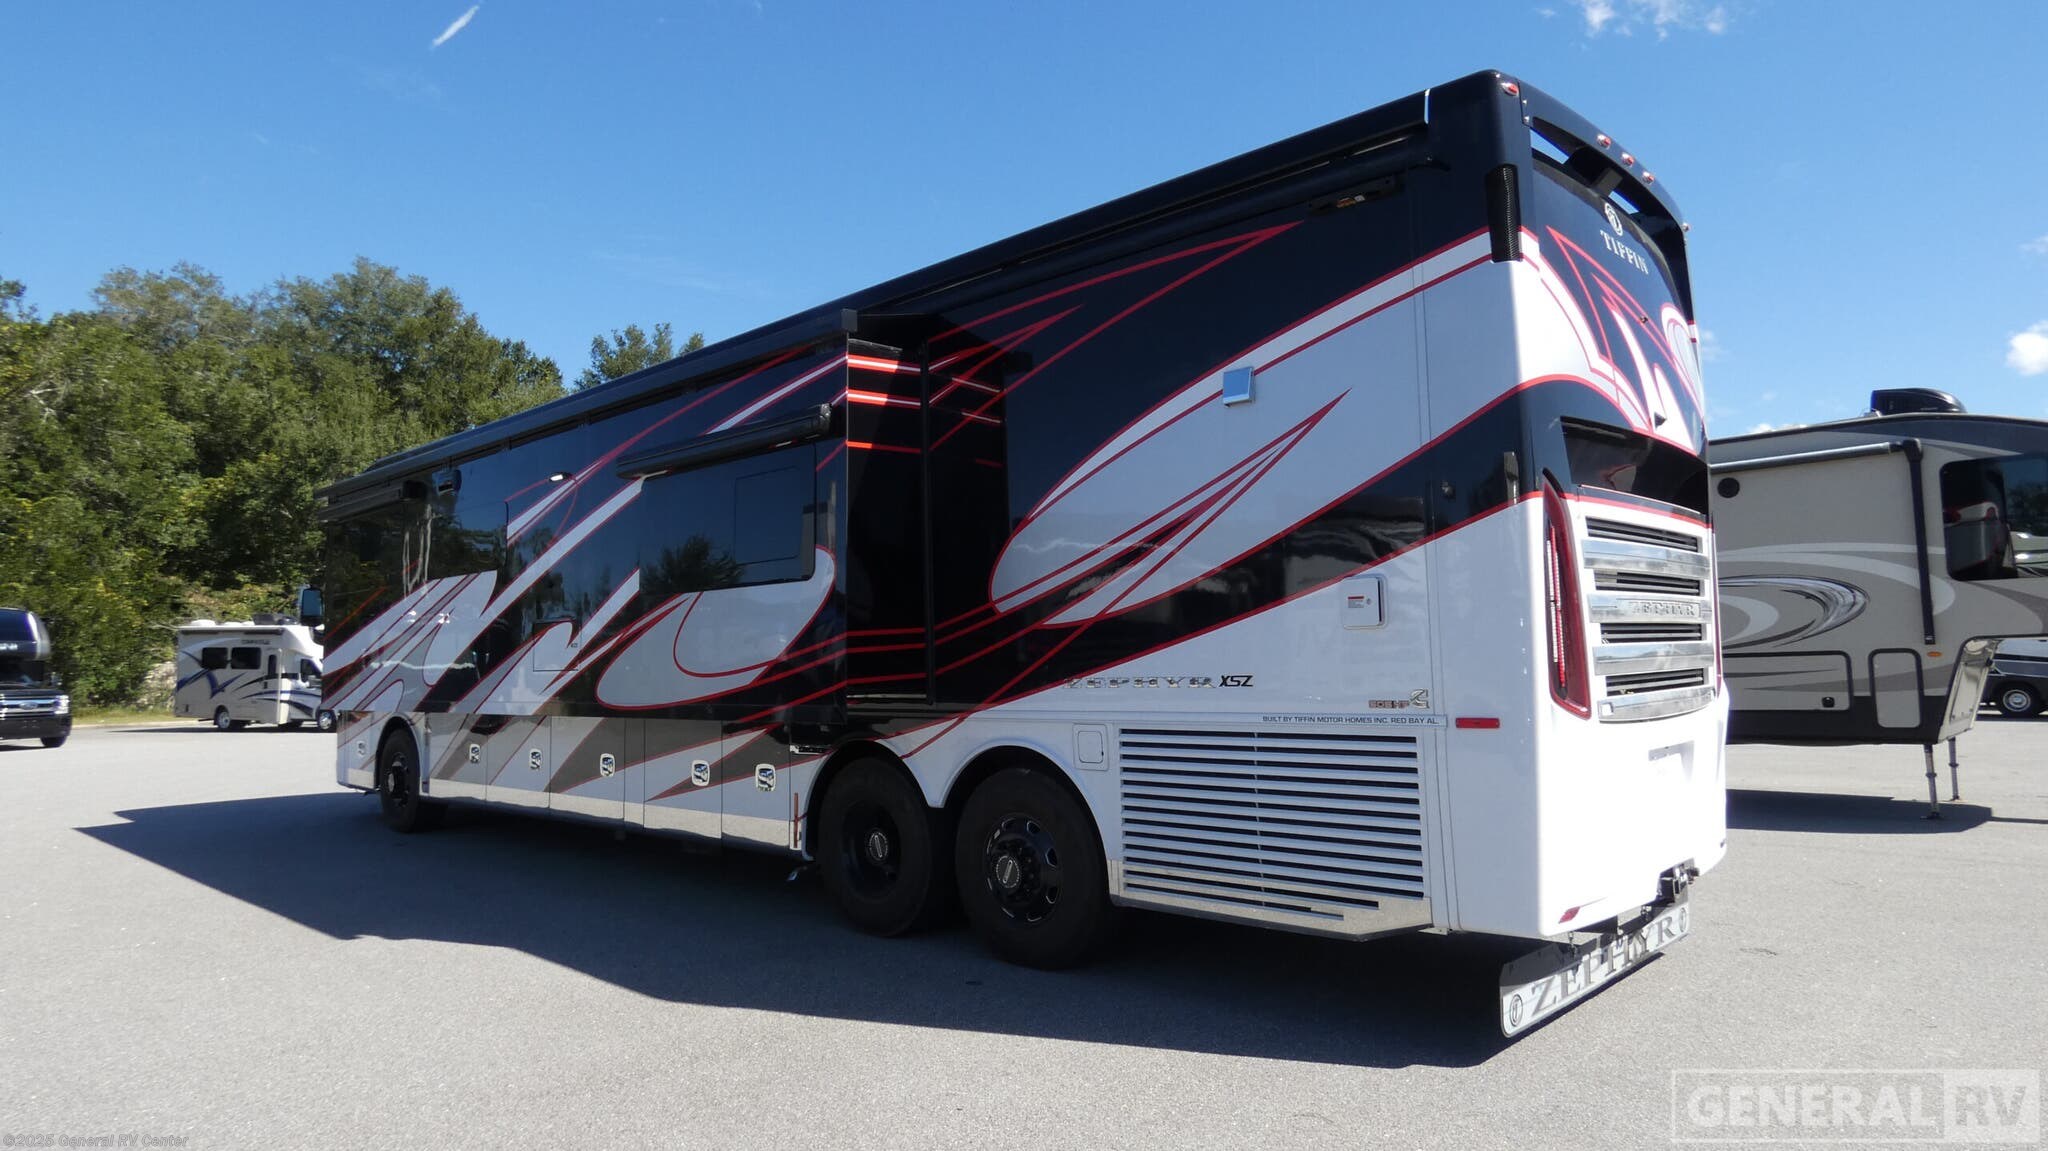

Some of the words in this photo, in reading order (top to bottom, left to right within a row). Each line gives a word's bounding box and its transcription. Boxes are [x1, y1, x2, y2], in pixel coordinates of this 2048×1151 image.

[1600, 229, 1649, 275] TIFFIN
[1262, 715, 1281, 723] BUILT
[1317, 716, 1343, 724] MOTOR
[1345, 716, 1372, 724] HOMES
[1531, 915, 1675, 1017] ZEPHYR
